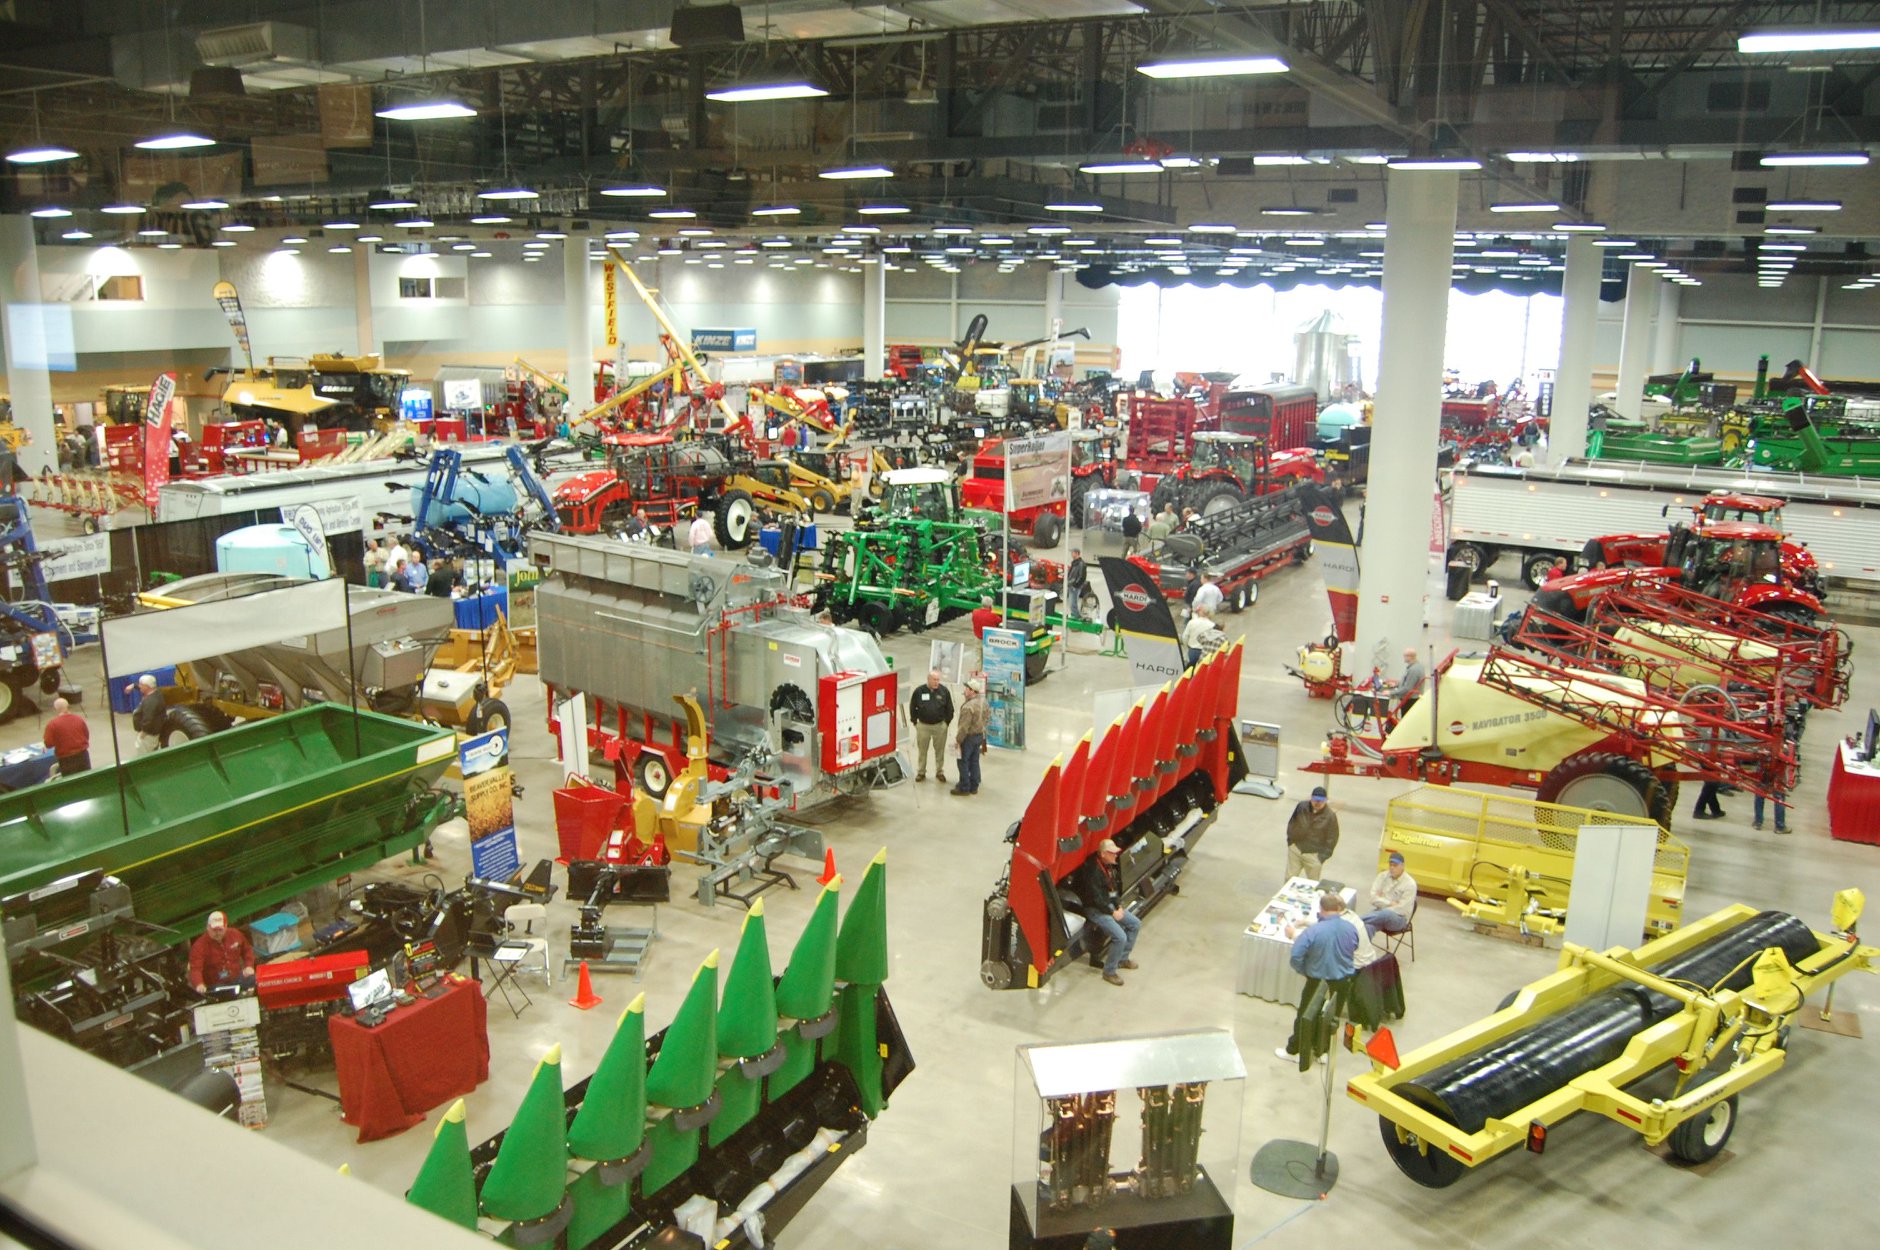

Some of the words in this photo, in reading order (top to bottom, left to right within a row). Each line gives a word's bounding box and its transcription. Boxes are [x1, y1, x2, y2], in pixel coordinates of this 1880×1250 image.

[604, 263, 617, 346] WESTFIELD
[694, 334, 732, 346] KINZE
[147, 375, 171, 425] HAGIE
[299, 517, 313, 534] DUO
[1323, 562, 1355, 573] HARDI
[1123, 593, 1148, 602] HARDI
[988, 638, 1018, 647] BROCK
[1136, 662, 1179, 676] HARDI
[1472, 714, 1522, 731] NAVIGATOR
[1525, 710, 1548, 722] 3500
[469, 779, 489, 793] BEAVER
[489, 772, 508, 785] VALLEY
[1391, 830, 1442, 849] Degelman
